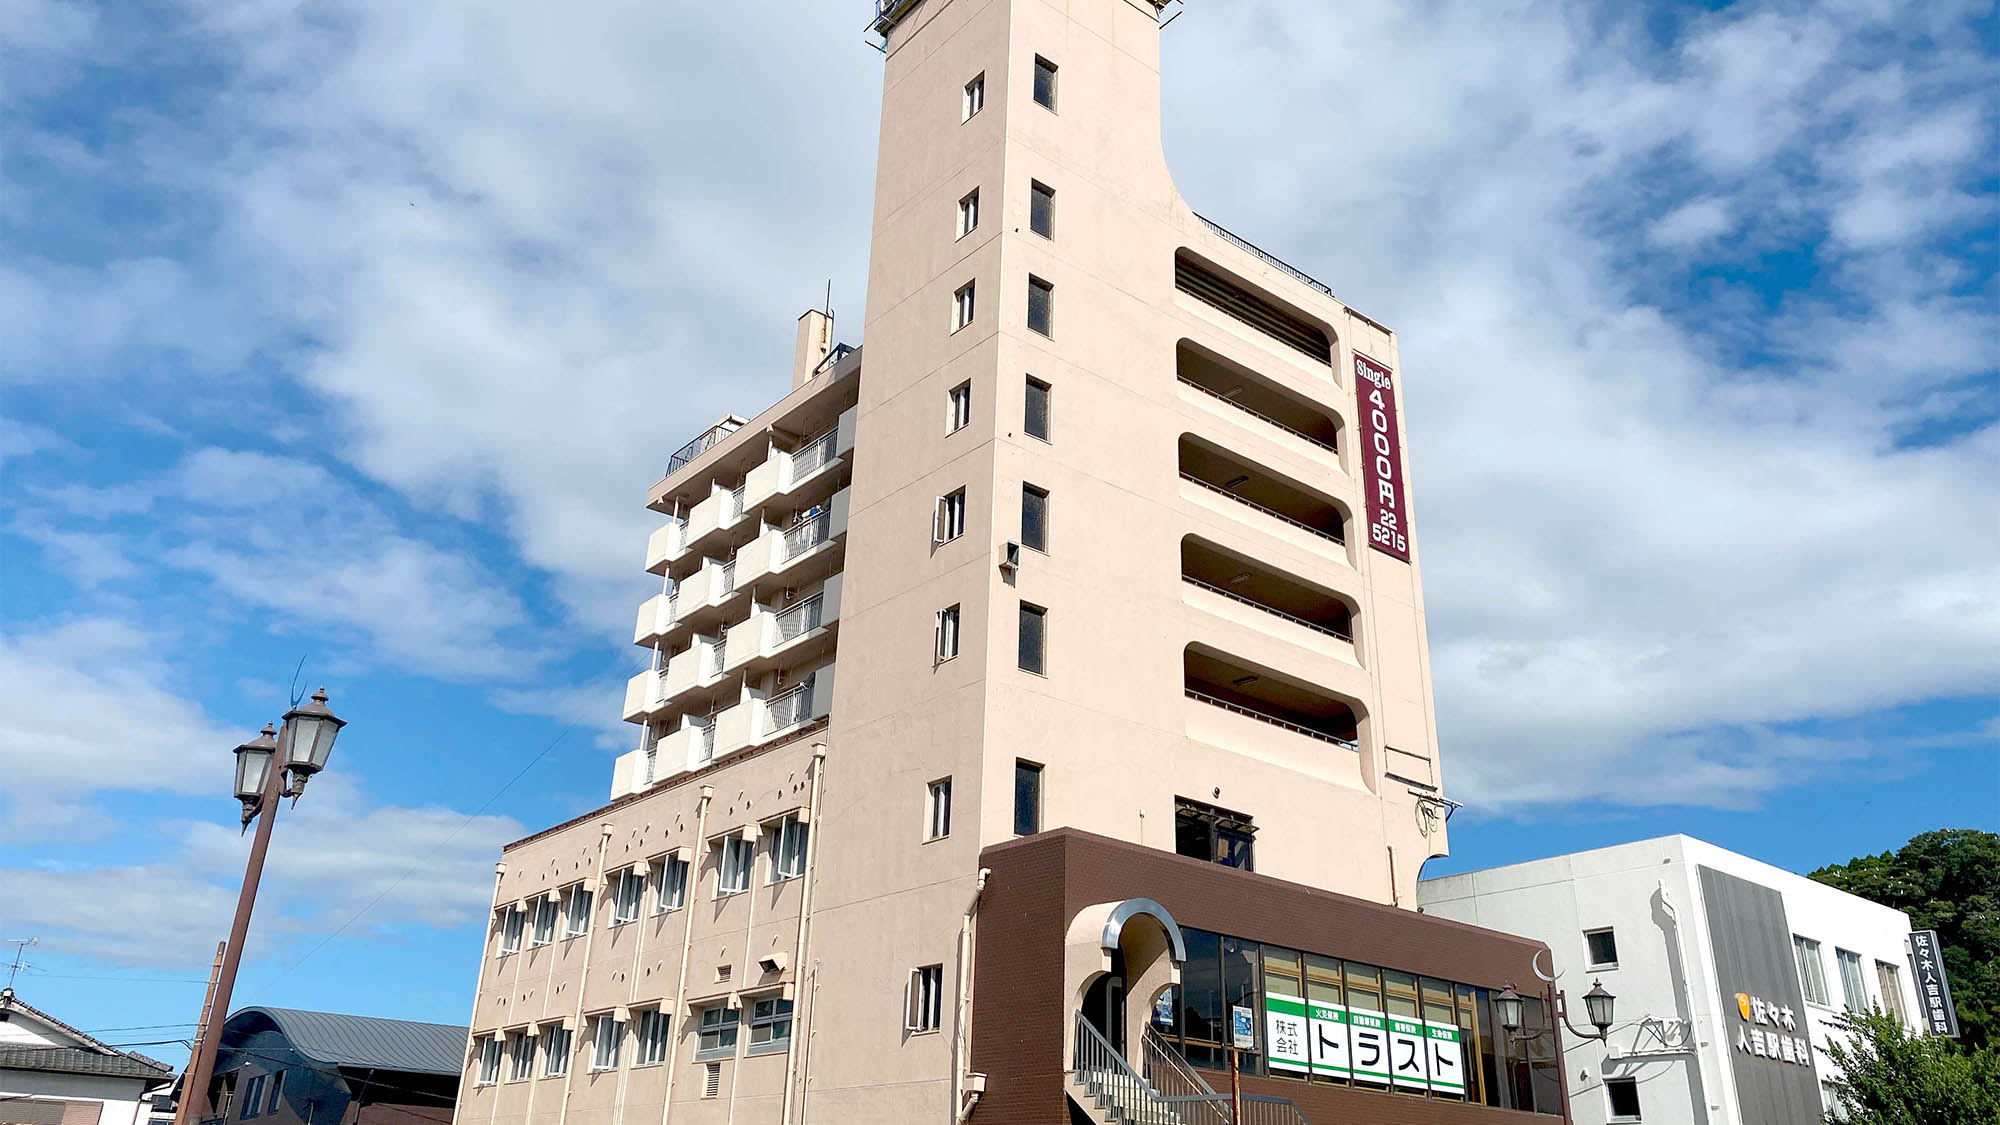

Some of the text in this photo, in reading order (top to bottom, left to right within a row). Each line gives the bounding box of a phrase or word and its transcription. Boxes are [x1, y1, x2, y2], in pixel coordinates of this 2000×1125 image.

[1356, 359, 1391, 390] Single
[1369, 389, 1395, 509] 4000円
[1380, 509, 1397, 531] 22
[1372, 523, 1406, 553] 5215
[1915, 935, 1948, 1034] 佐々木人吉駅歯科
[1275, 1019, 1298, 1038] 株式
[1750, 996, 1796, 1032] 佐々木
[1276, 1037, 1299, 1056] 会社
[1318, 1023, 1454, 1076] トラスト
[1736, 1025, 1810, 1067] 人吉駅歯科
